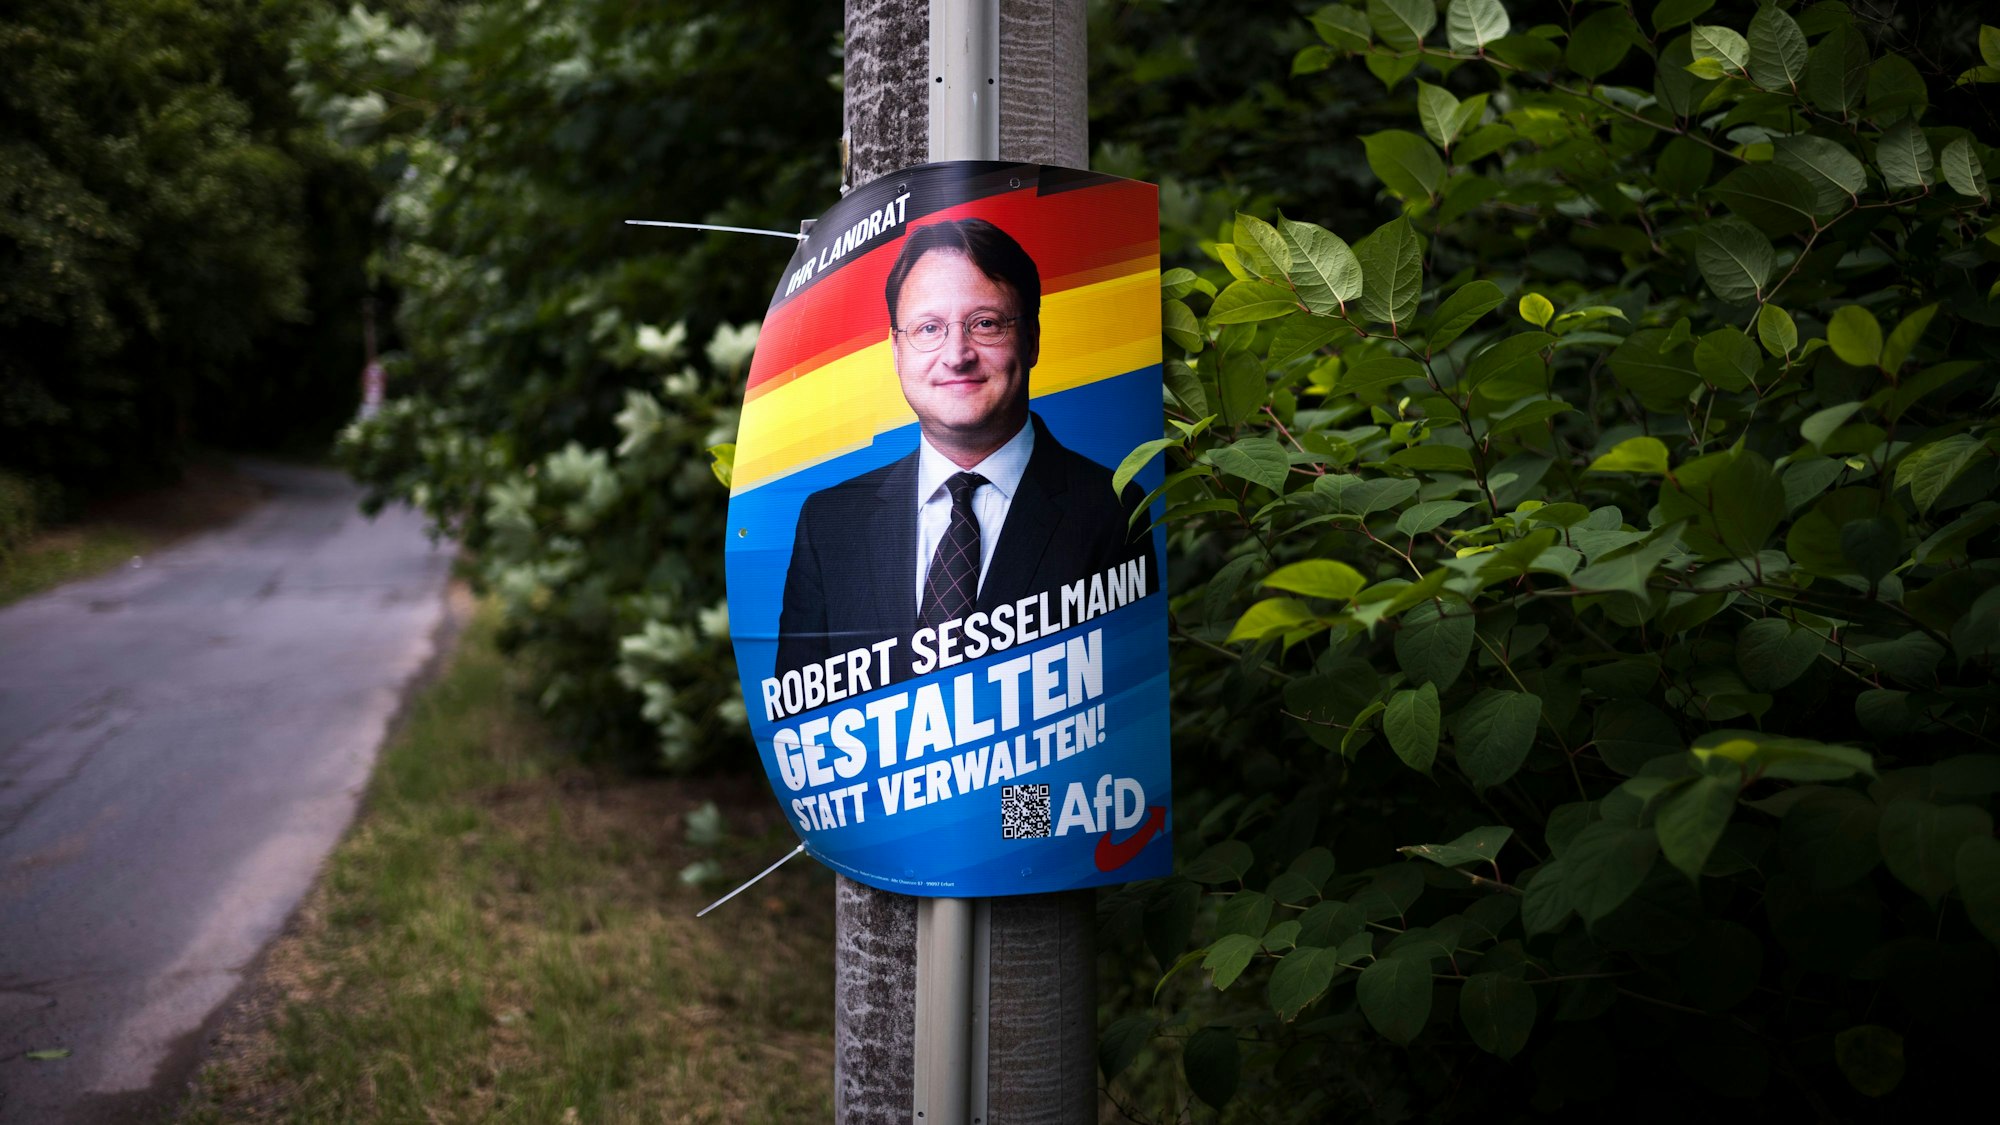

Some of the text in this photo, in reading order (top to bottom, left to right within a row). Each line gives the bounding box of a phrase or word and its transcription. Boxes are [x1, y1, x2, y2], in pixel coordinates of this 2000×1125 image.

[785, 192, 911, 297] IHR LANDRAT
[761, 555, 1147, 722] ROBERT SESSELMANN
[772, 628, 1104, 793] GESTALTEN
[791, 703, 1106, 833] STATT VERWALTEN!
[1055, 774, 1146, 837] AfD
